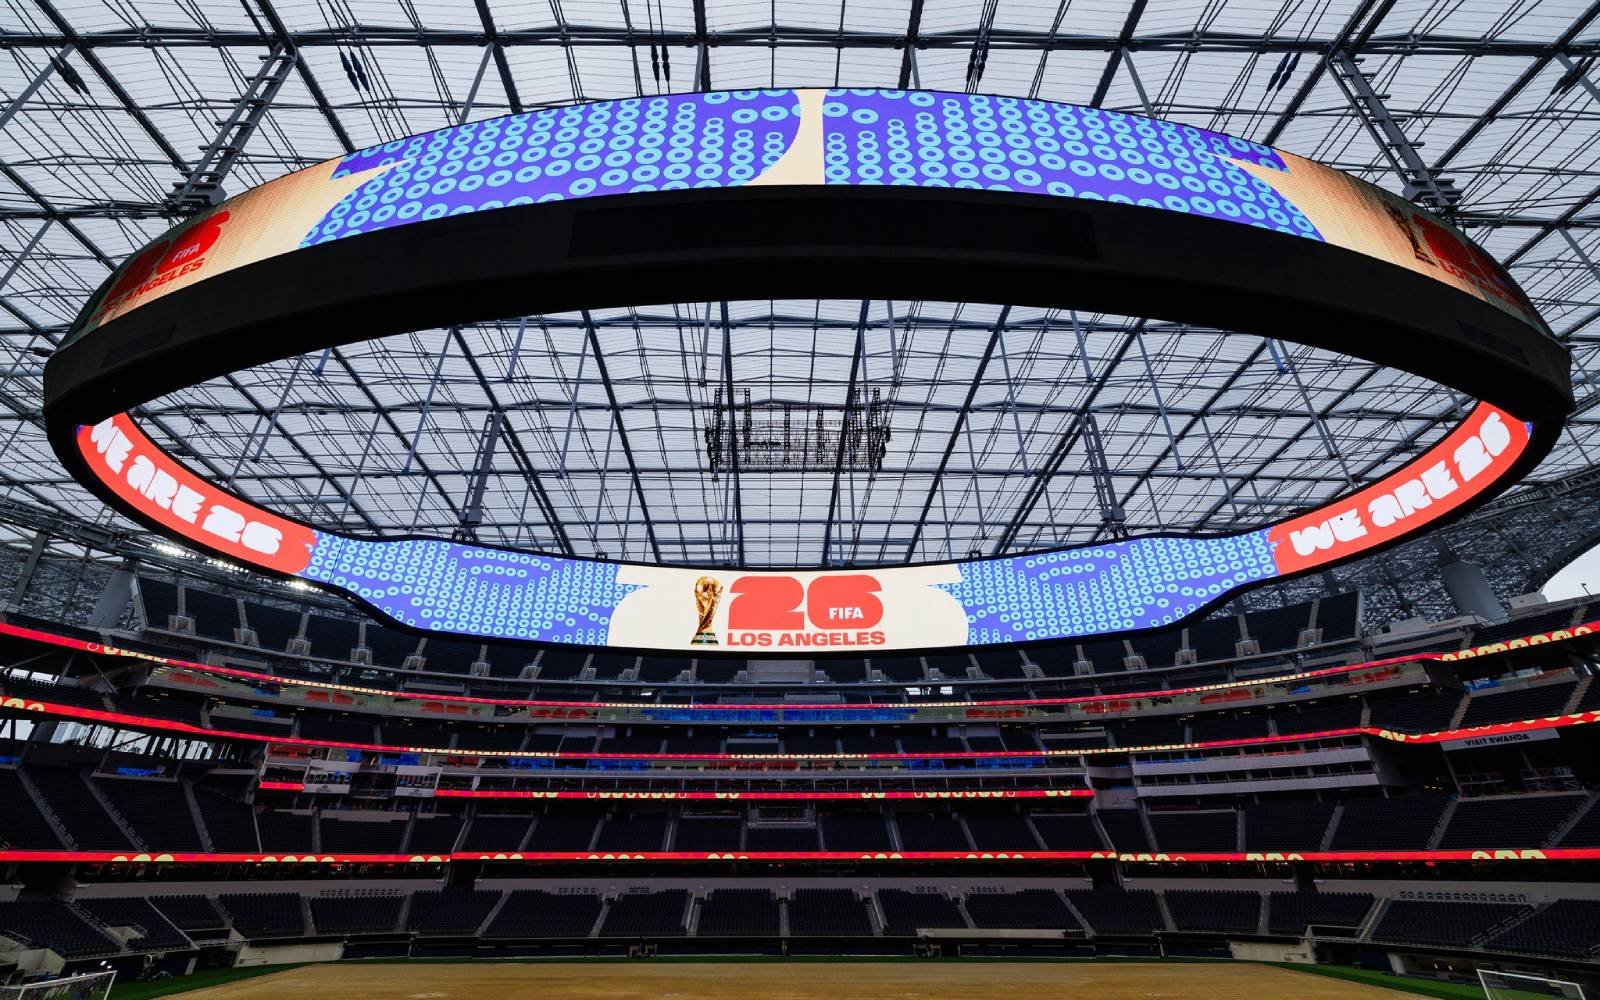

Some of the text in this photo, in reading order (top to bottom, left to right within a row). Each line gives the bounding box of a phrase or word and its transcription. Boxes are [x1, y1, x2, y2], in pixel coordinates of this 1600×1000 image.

[91, 416, 283, 555] WE ARE 26
[1288, 411, 1511, 556] WE ARE 26
[728, 575, 884, 630] 26
[829, 607, 864, 620] FIFA
[727, 631, 886, 646] LOS ANGELES
[1464, 733, 1530, 747] VISIT RWANDA
